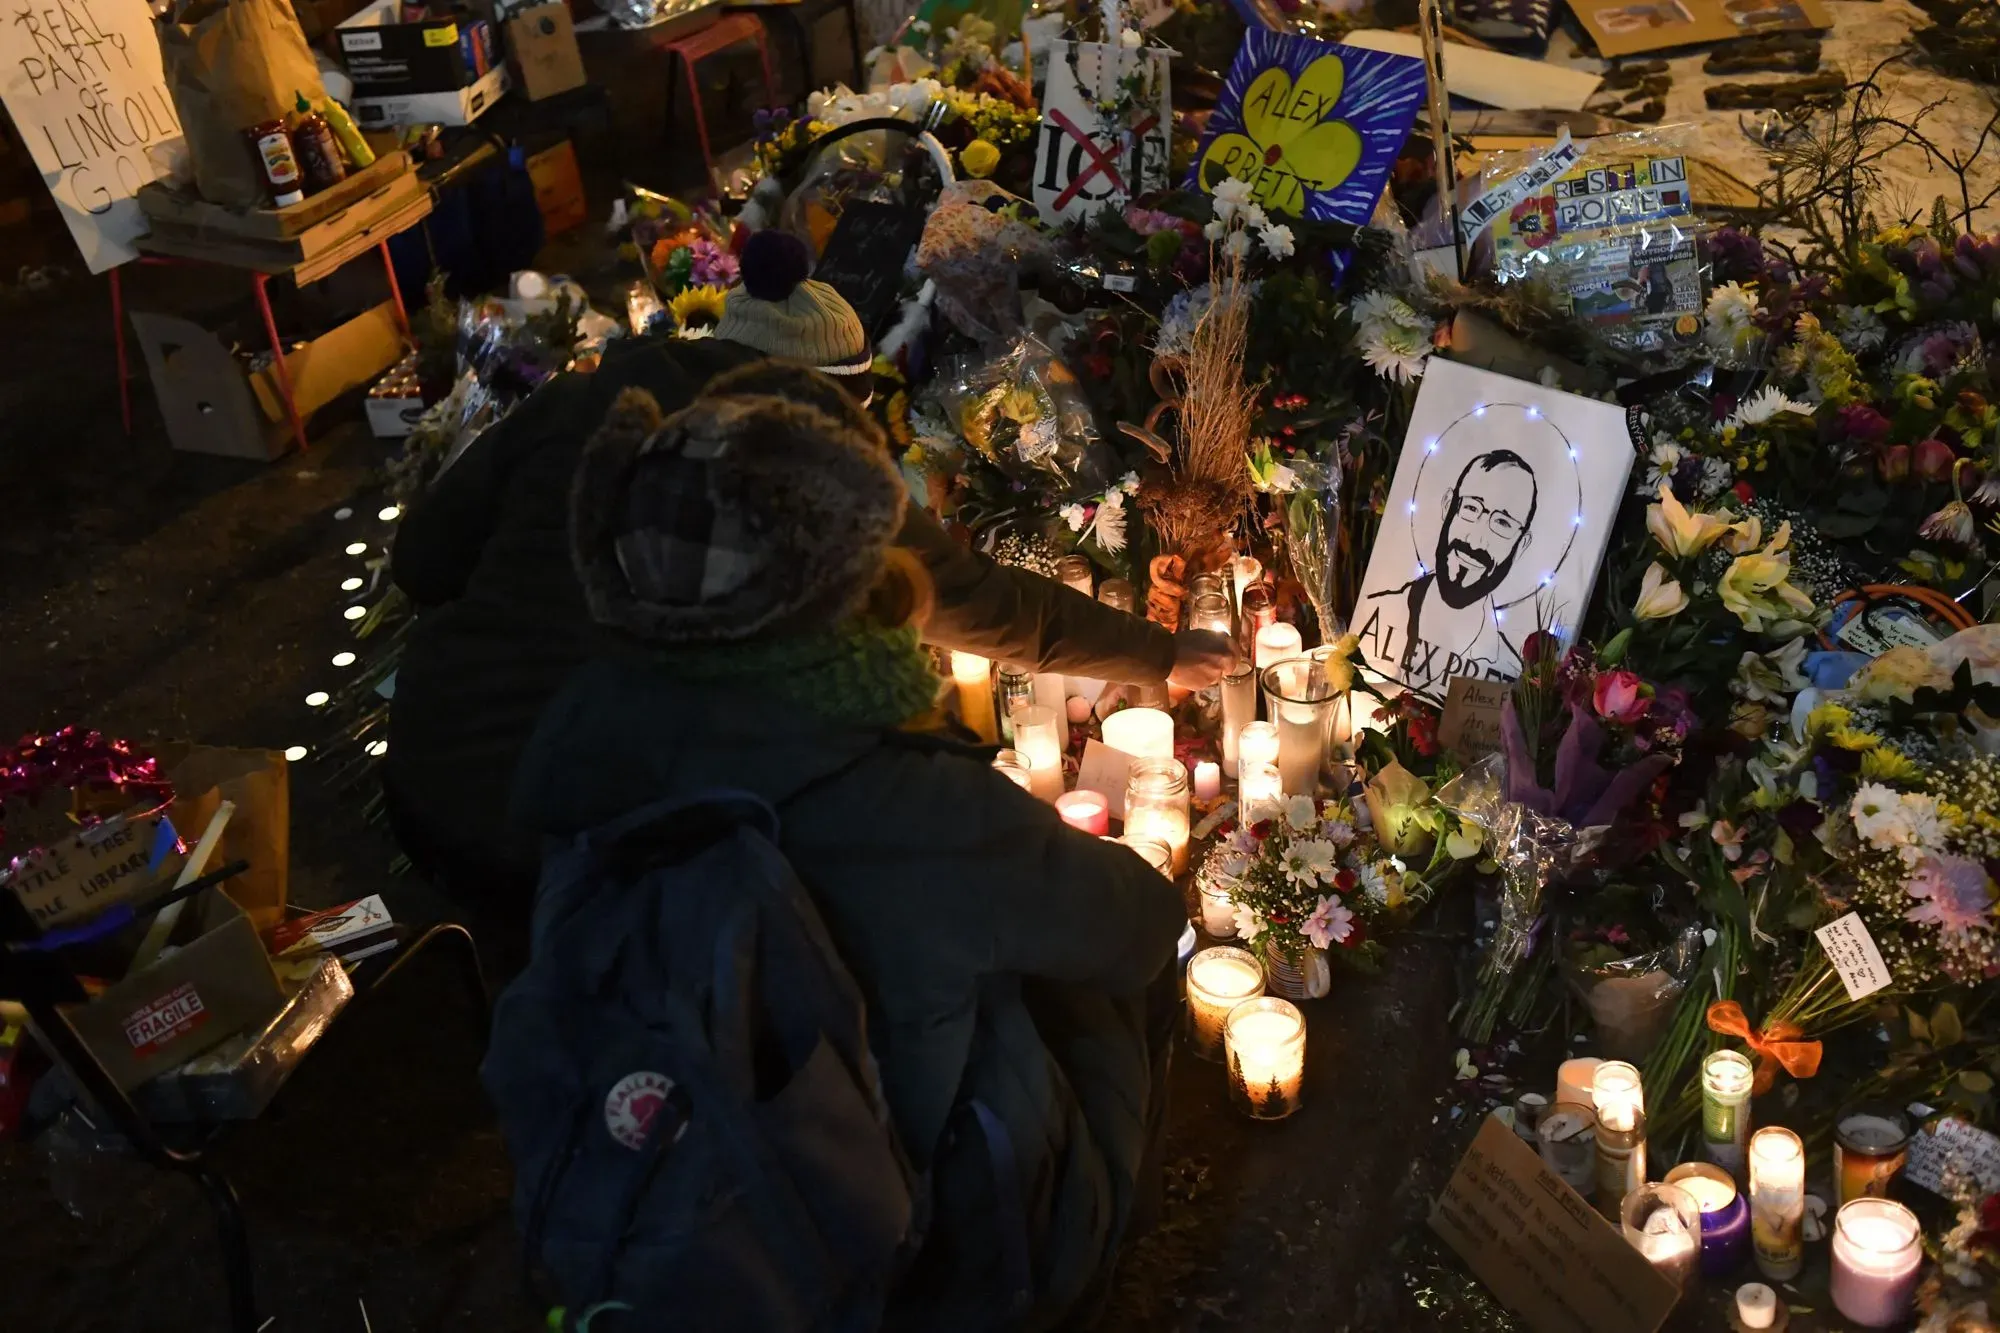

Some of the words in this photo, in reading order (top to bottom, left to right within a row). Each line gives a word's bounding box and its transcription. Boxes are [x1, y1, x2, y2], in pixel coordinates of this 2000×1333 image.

[14, 0, 115, 55] REAL
[19, 33, 133, 96] PARTY
[79, 82, 108, 111] OF
[1250, 79, 1332, 127] ALEX
[1038, 124, 1166, 202] ICE
[1554, 163, 1636, 198] REST
[1650, 158, 1684, 185] IN
[1571, 281, 1607, 292] UPPORT
[1358, 606, 1440, 682] ALEX
[1463, 686, 1495, 706] Alex
[90, 822, 134, 858] FREE
[1825, 928, 1843, 954] Justice
[1832, 926, 1842, 936] not
[1842, 920, 1853, 936] Your
[1867, 967, 1877, 984] were
[128, 995, 201, 1045] FRAGILE
